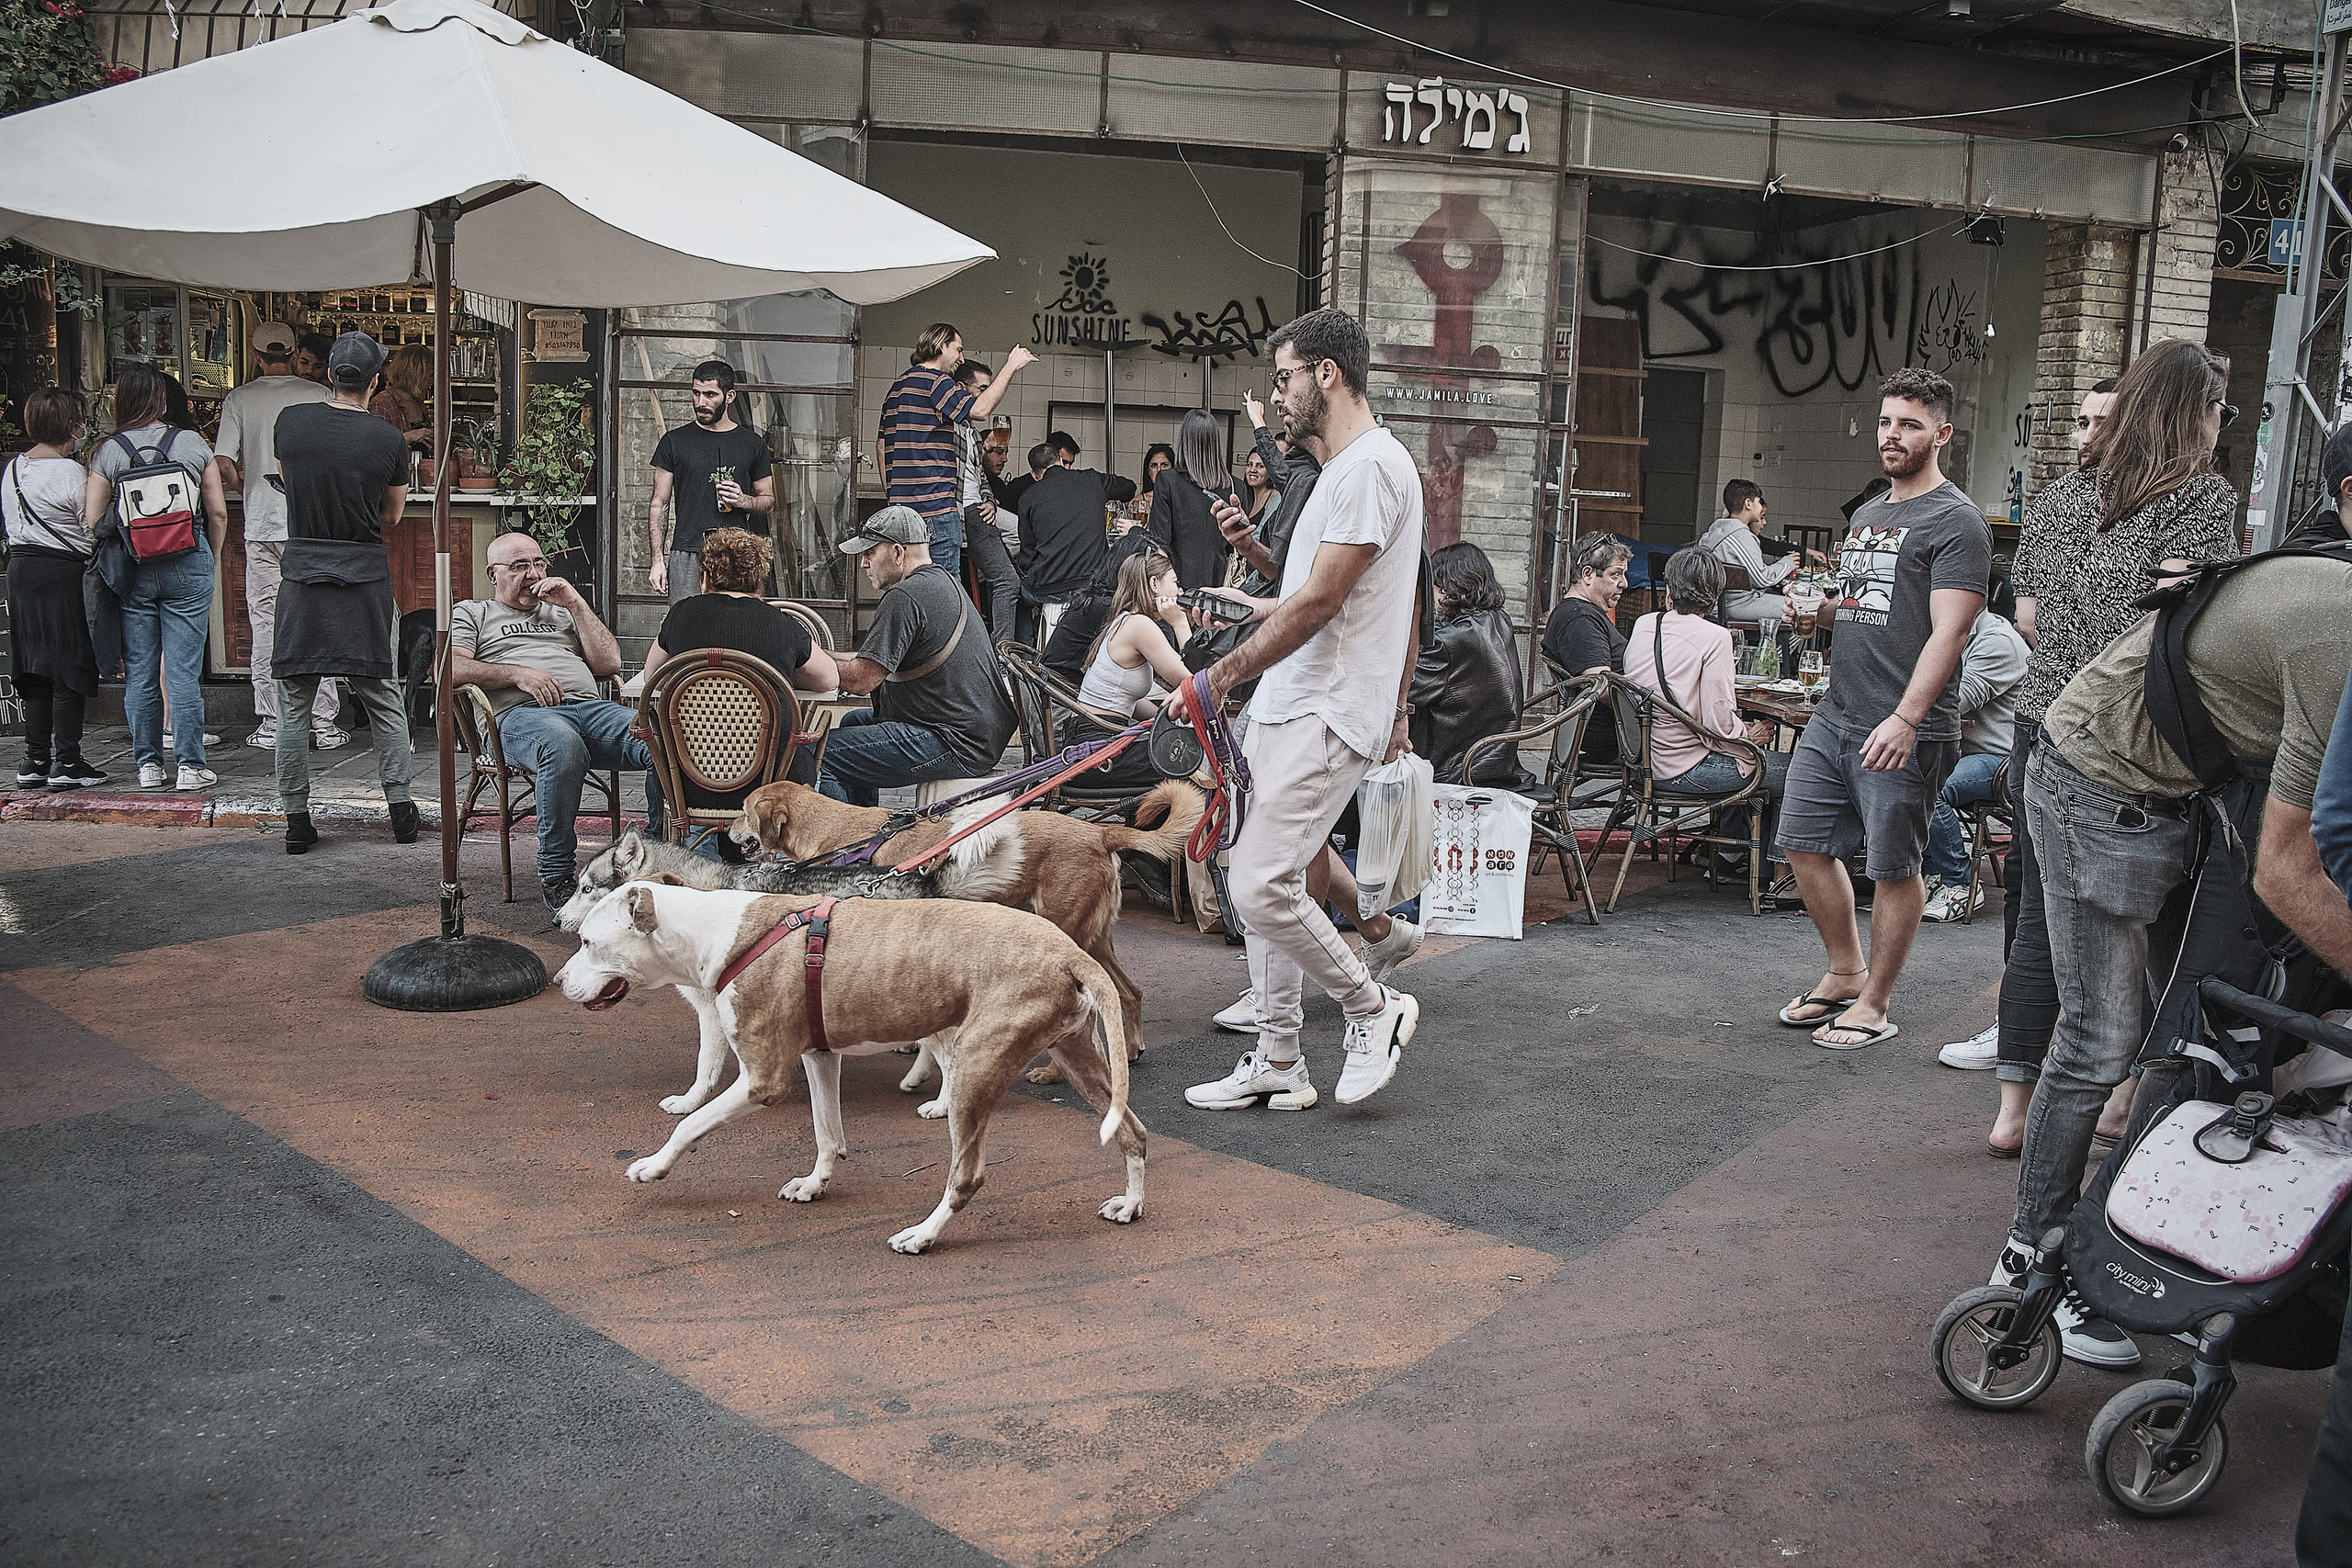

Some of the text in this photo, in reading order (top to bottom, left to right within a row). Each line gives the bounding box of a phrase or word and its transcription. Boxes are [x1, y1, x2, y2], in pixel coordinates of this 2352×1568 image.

[2274, 229, 2302, 255] 41
[1032, 313, 1132, 346] SUNSHINE
[1385, 387, 1493, 404] WWW.JAMILA.LOVE
[1854, 610, 1889, 627] PERSON
[501, 621, 557, 637] COLLEGE
